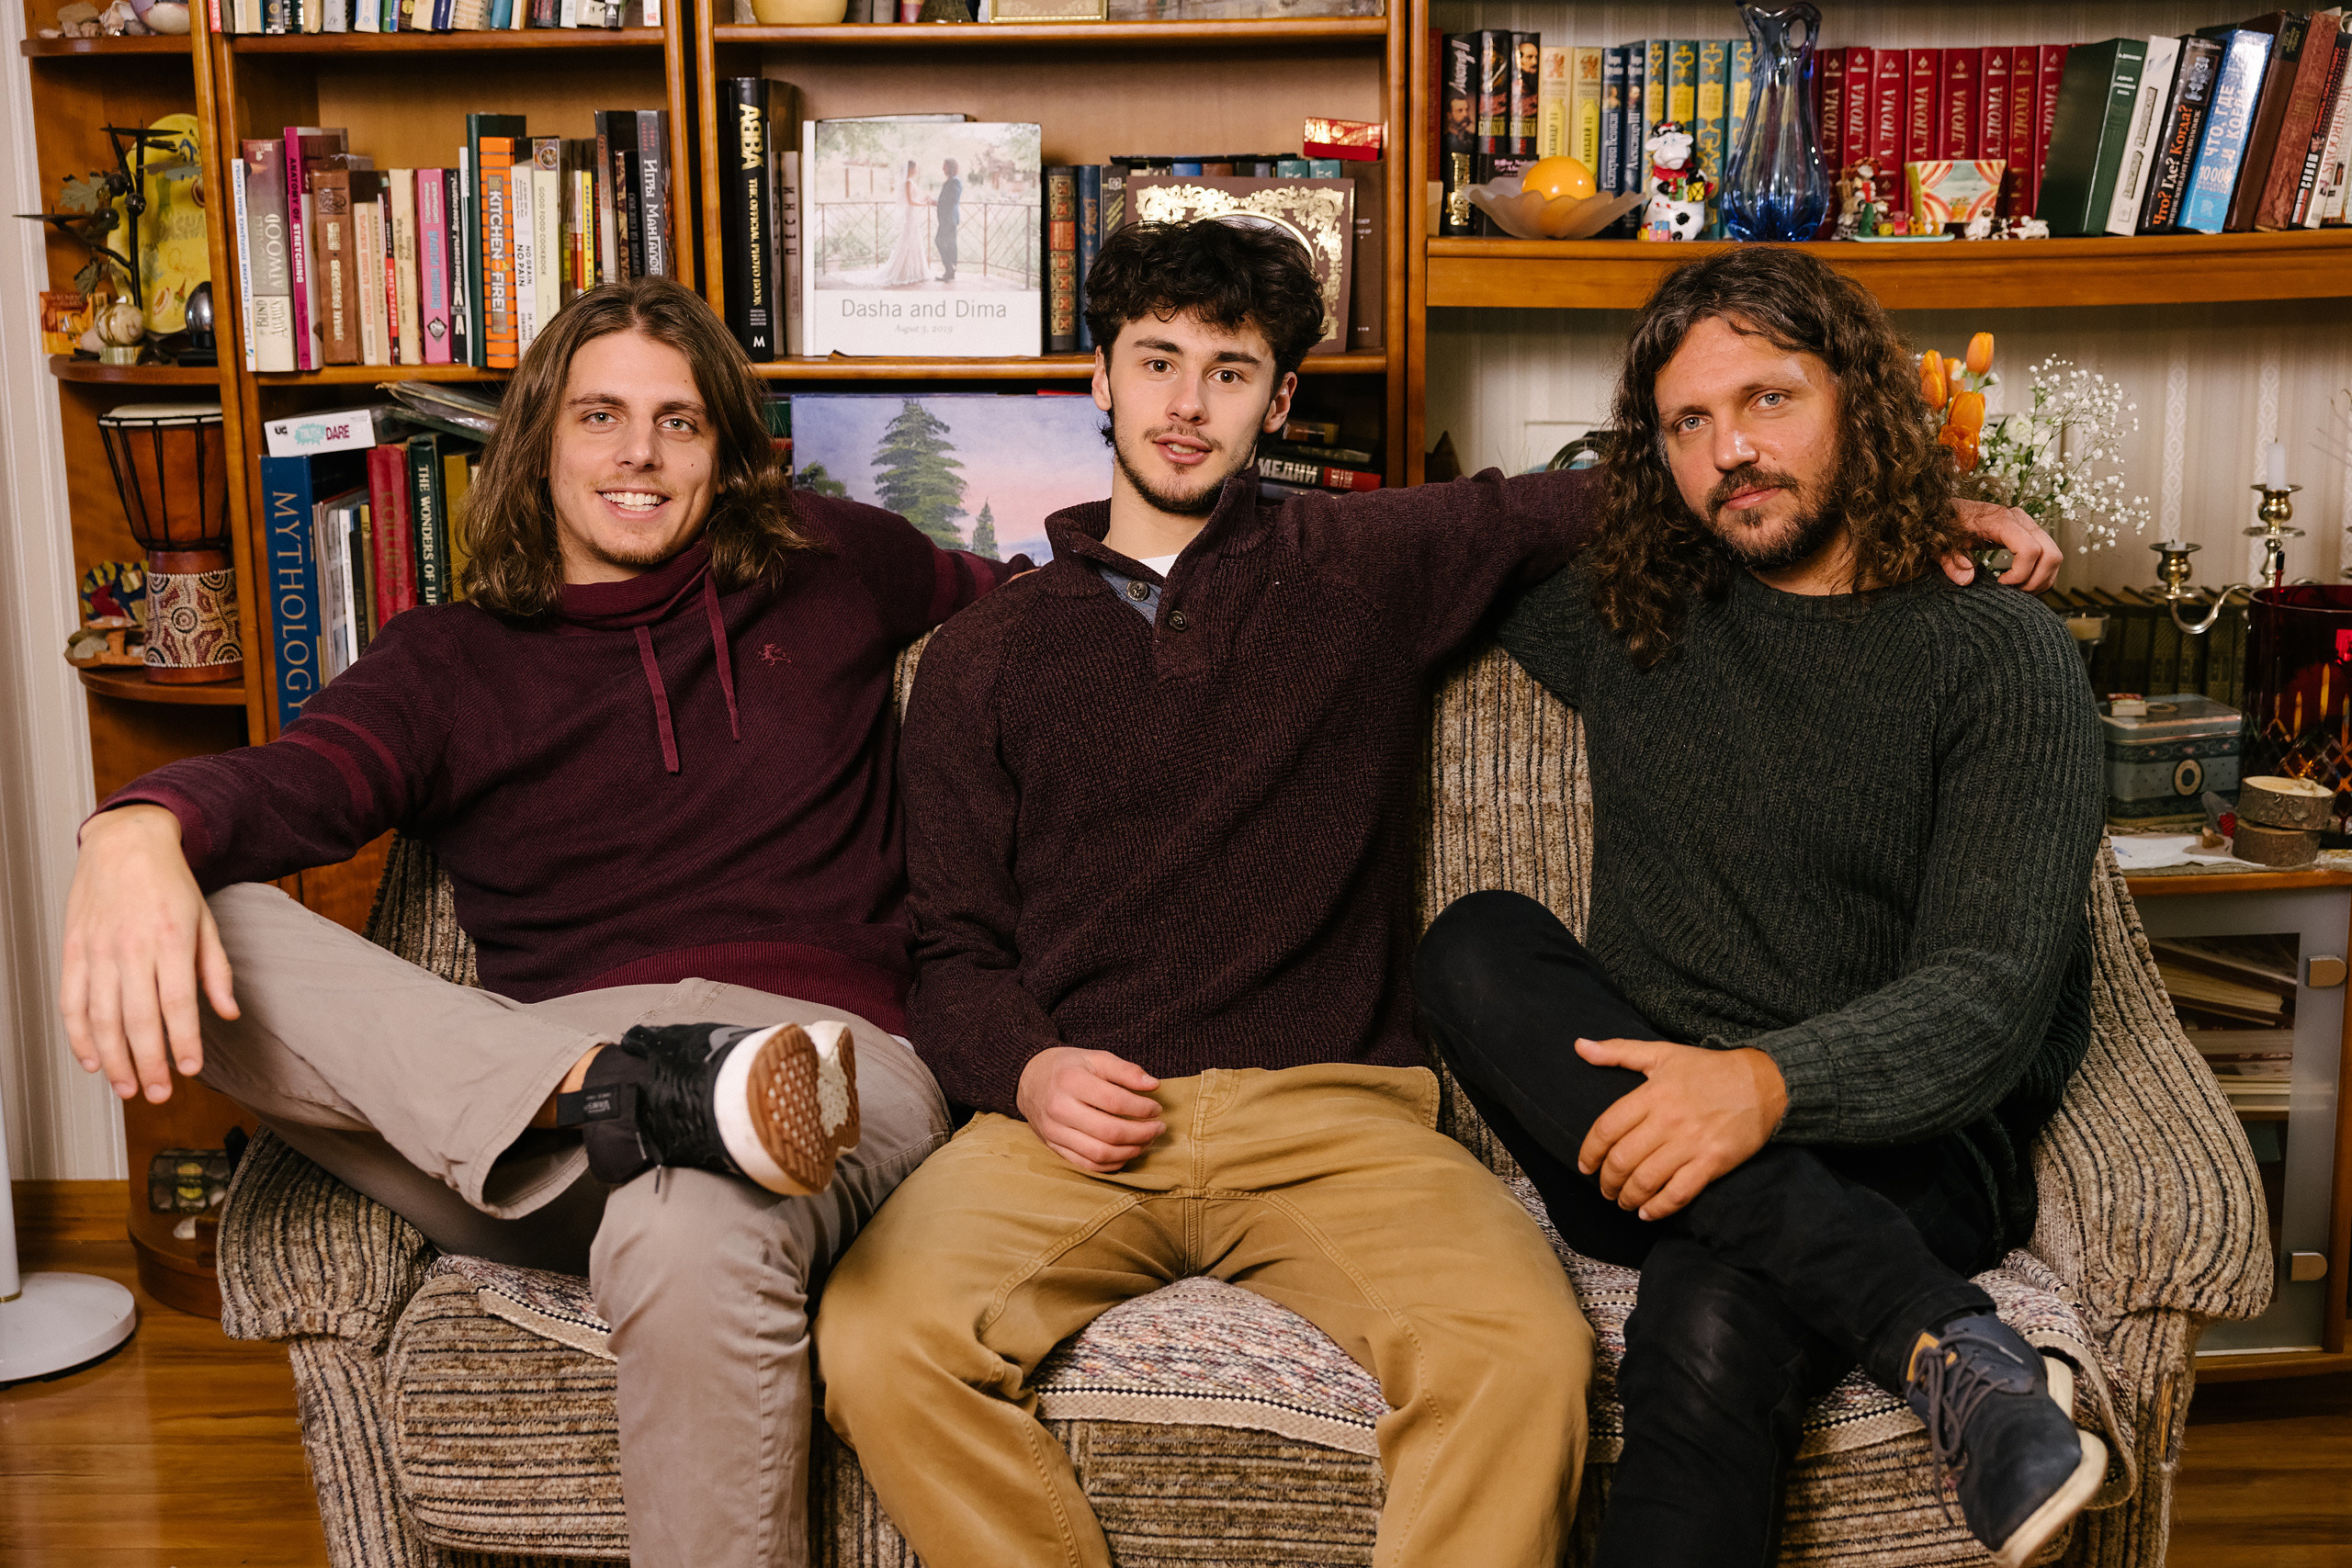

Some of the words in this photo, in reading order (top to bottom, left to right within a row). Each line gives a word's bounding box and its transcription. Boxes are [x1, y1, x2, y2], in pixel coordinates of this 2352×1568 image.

[739, 103, 764, 170] ABBA
[289, 158, 301, 205] ANATOMY
[292, 207, 301, 220] OF
[488, 190, 504, 260] KITCHEN
[749, 197, 761, 242] OFFICIAL
[783, 186, 797, 255] ПЕСНИ
[2153, 190, 2172, 226] Что?
[265, 213, 285, 289] ATWOOD
[292, 222, 305, 284] STRETCHING
[516, 243, 524, 262] NO
[526, 244, 532, 257] NO
[751, 243, 762, 277] PHOTO
[491, 272, 506, 312] FIRE!
[842, 299, 902, 318] Dasha
[910, 299, 946, 318] and
[956, 299, 1007, 318] Dima
[753, 335, 765, 347] M
[932, 324, 954, 334] 2019
[325, 424, 350, 440] DARE
[418, 464, 432, 492] THE
[380, 491, 404, 597] COLLIER'S
[419, 495, 435, 561] WONDERS
[423, 564, 435, 583] OF
[272, 491, 313, 710] MYTHOLOGY
